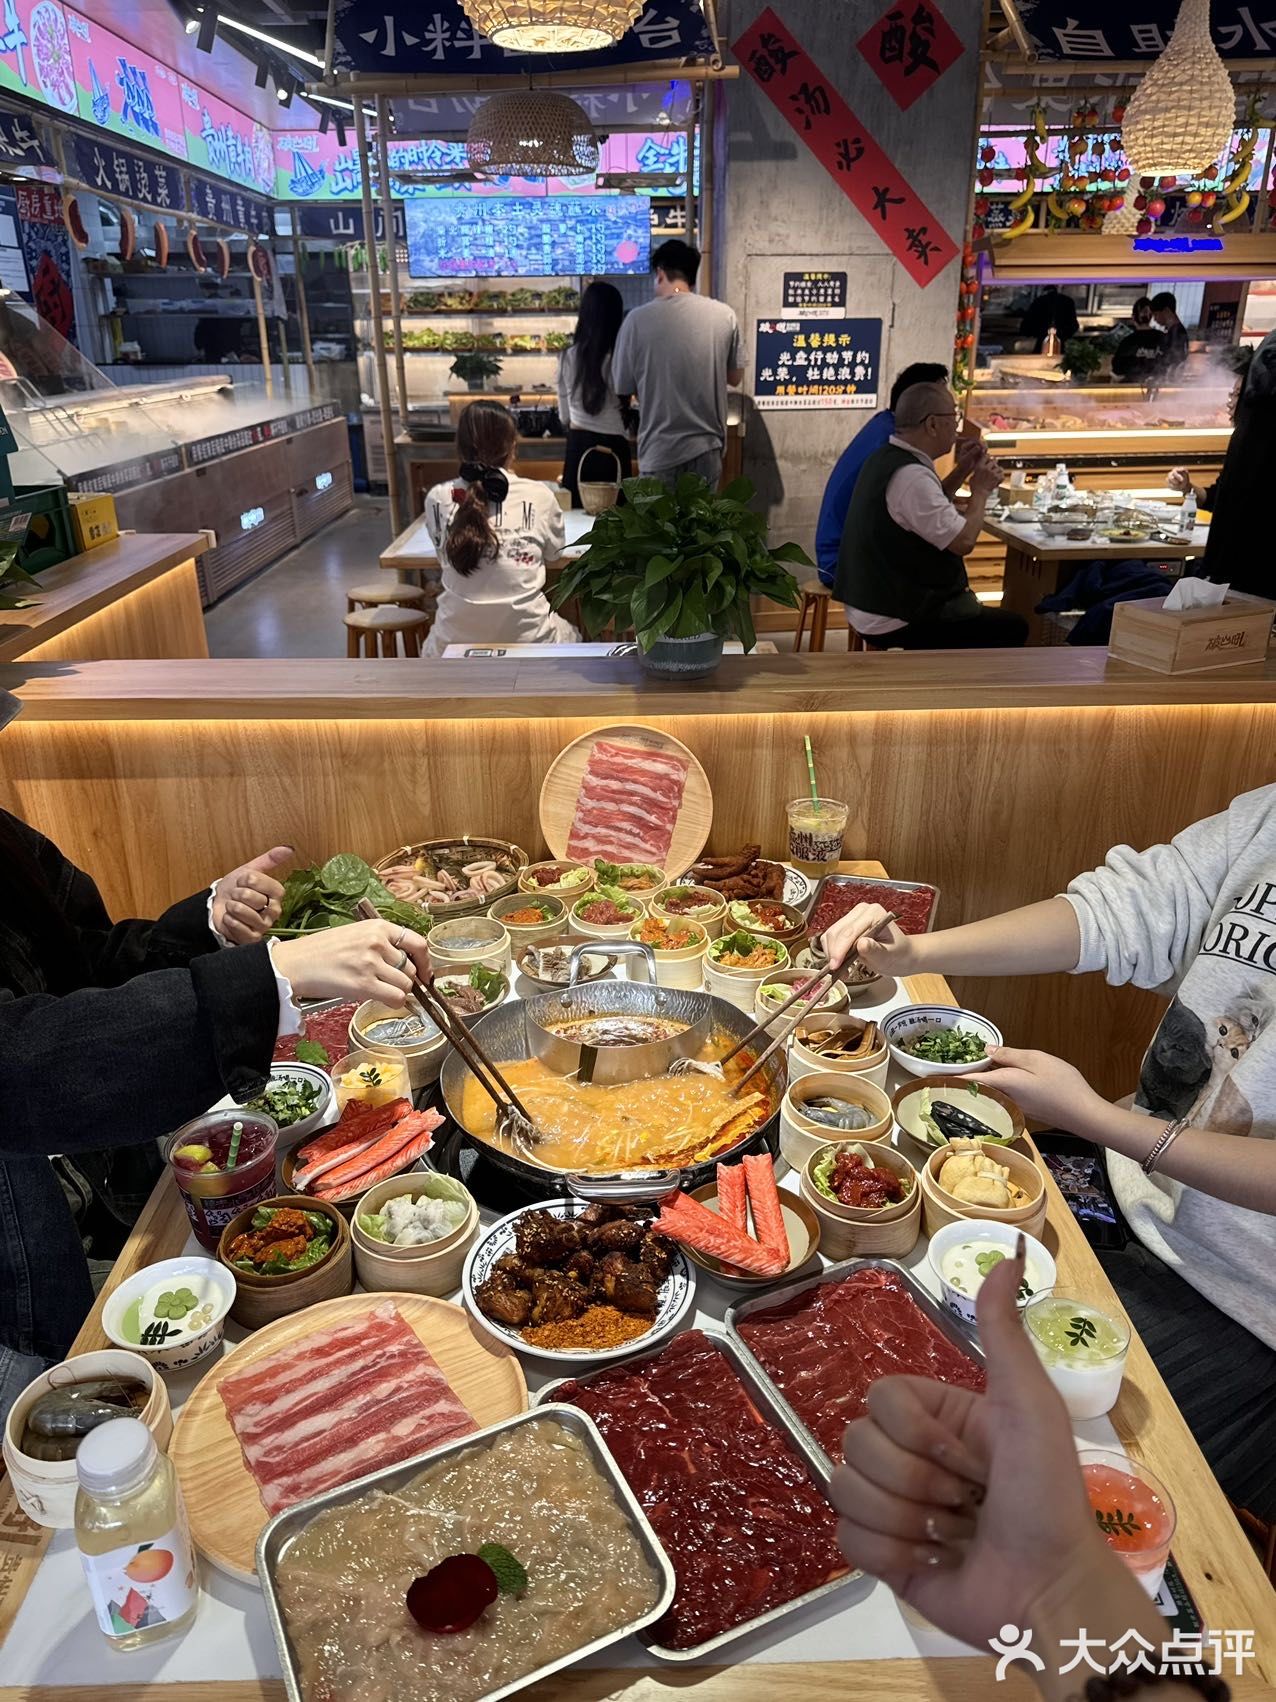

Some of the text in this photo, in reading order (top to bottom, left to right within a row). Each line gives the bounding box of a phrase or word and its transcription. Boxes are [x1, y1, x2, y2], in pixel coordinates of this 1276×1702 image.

[879, 3, 941, 77] 酸
[748, 31, 942, 265] 酸汤必大卖
[94, 147, 170, 207] 火锅烫菜
[778, 351, 870, 365] 光盘行动节约
[793, 333, 851, 347] 温馨提示
[775, 384, 857, 396] 用餐时间120分钟
